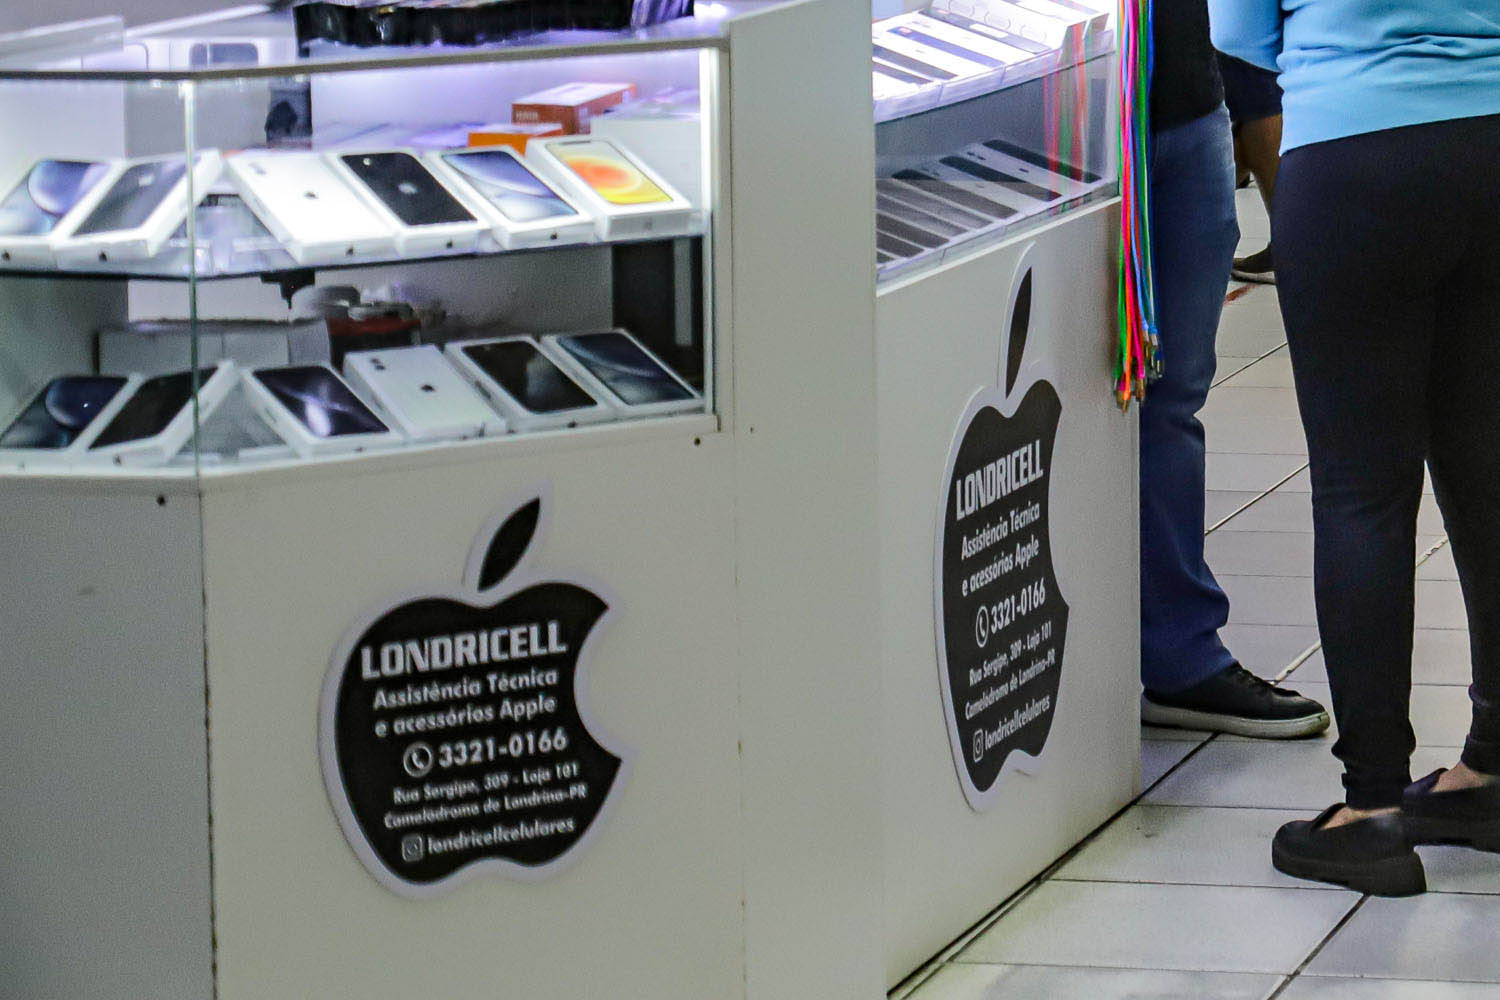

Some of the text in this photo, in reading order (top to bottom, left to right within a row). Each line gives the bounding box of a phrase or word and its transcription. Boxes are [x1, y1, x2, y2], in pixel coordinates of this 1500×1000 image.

[956, 439, 1045, 521] LONDRICELL
[961, 500, 1041, 560] Assistência Técnica
[962, 534, 1040, 597] e acessórios Apple
[990, 577, 1046, 634] 3321-0166
[361, 619, 568, 681] LONDRICELL
[969, 667, 982, 687] Rua
[1027, 629, 1040, 651] Loja
[1041, 620, 1052, 643] 101
[1010, 672, 1018, 691] de
[1019, 648, 1056, 686] Londrina-PR
[373, 667, 559, 711] Assistência Técnica
[375, 693, 557, 738] e acessórios Apple
[984, 694, 1050, 751] londricellcelulares
[438, 726, 569, 768] 3321-0166
[393, 786, 420, 805] Rua
[424, 780, 479, 802] Sergipe,
[484, 771, 509, 790] 309
[522, 766, 552, 786] Loja
[555, 760, 580, 779] 101
[484, 796, 501, 814] de
[504, 782, 588, 810] Londrina-PR
[427, 816, 577, 855] londricellcelulares
